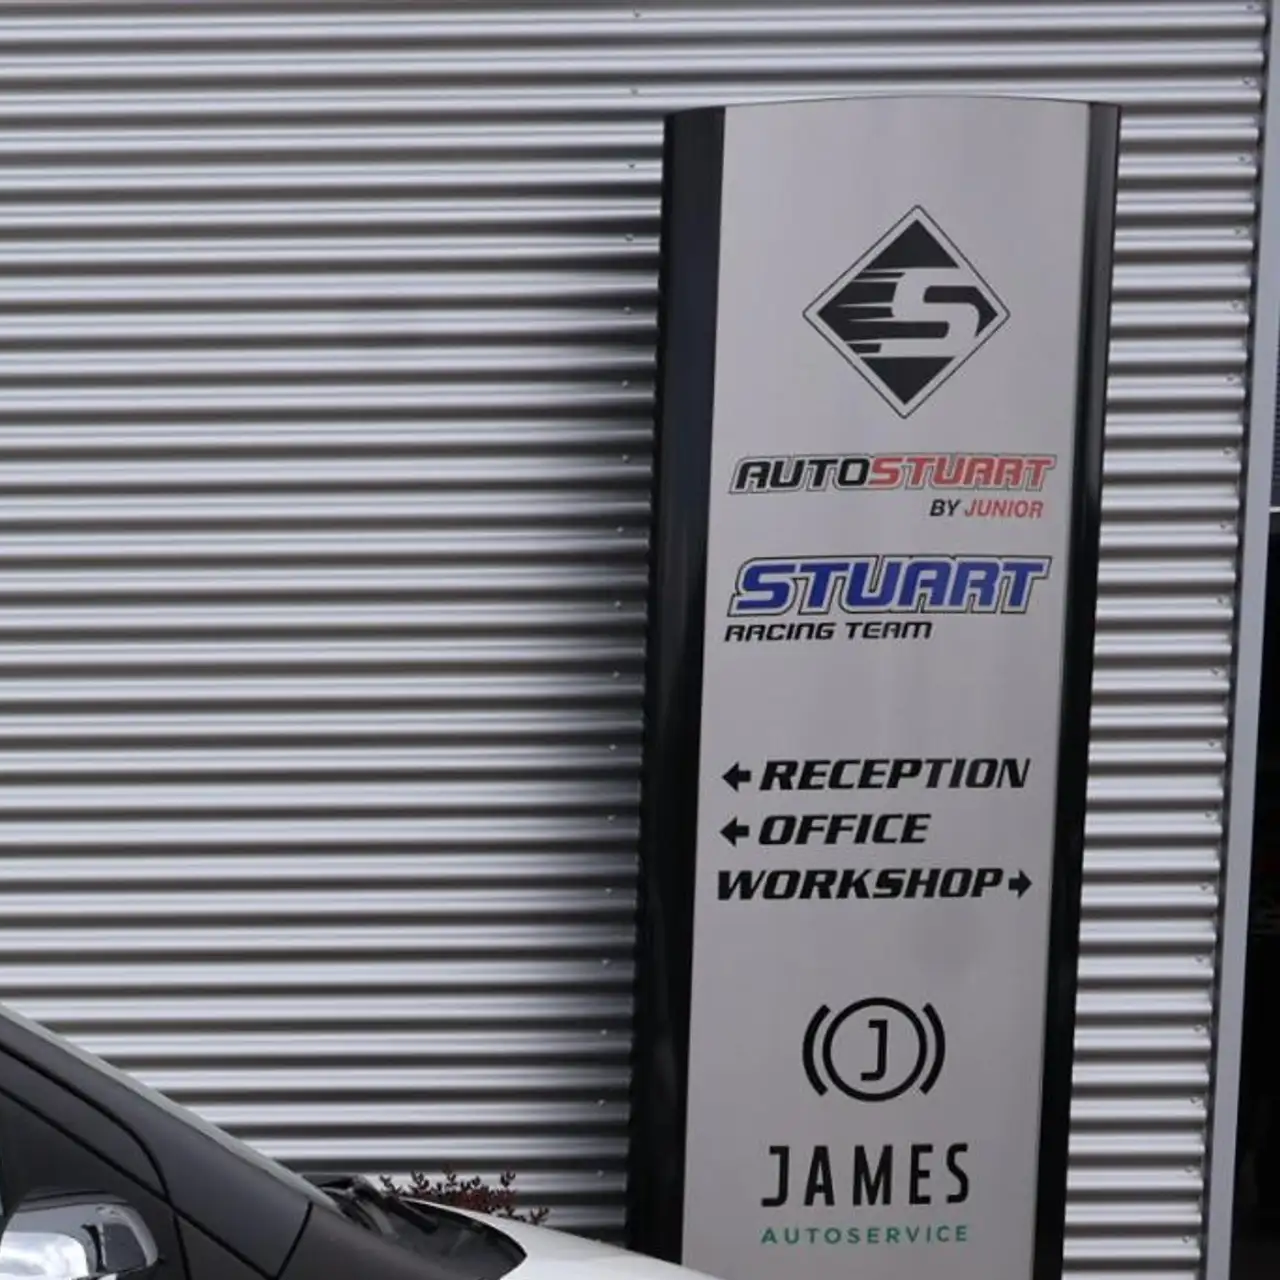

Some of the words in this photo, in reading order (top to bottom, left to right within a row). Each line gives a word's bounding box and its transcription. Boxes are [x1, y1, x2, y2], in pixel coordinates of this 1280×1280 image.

[731, 454, 1055, 493] AUTOSTUART
[930, 499, 961, 517] BY
[964, 499, 1044, 518] JUNIOR
[730, 556, 1051, 616] STUART
[724, 622, 836, 642] RACING
[845, 621, 932, 640] TEAM
[759, 758, 1031, 791] RECEPTION
[758, 813, 932, 845] OFFICE
[717, 867, 1004, 901] WORKSHOP
[760, 1142, 970, 1208] JAMES
[760, 1225, 969, 1244] AUTOSERVICE
